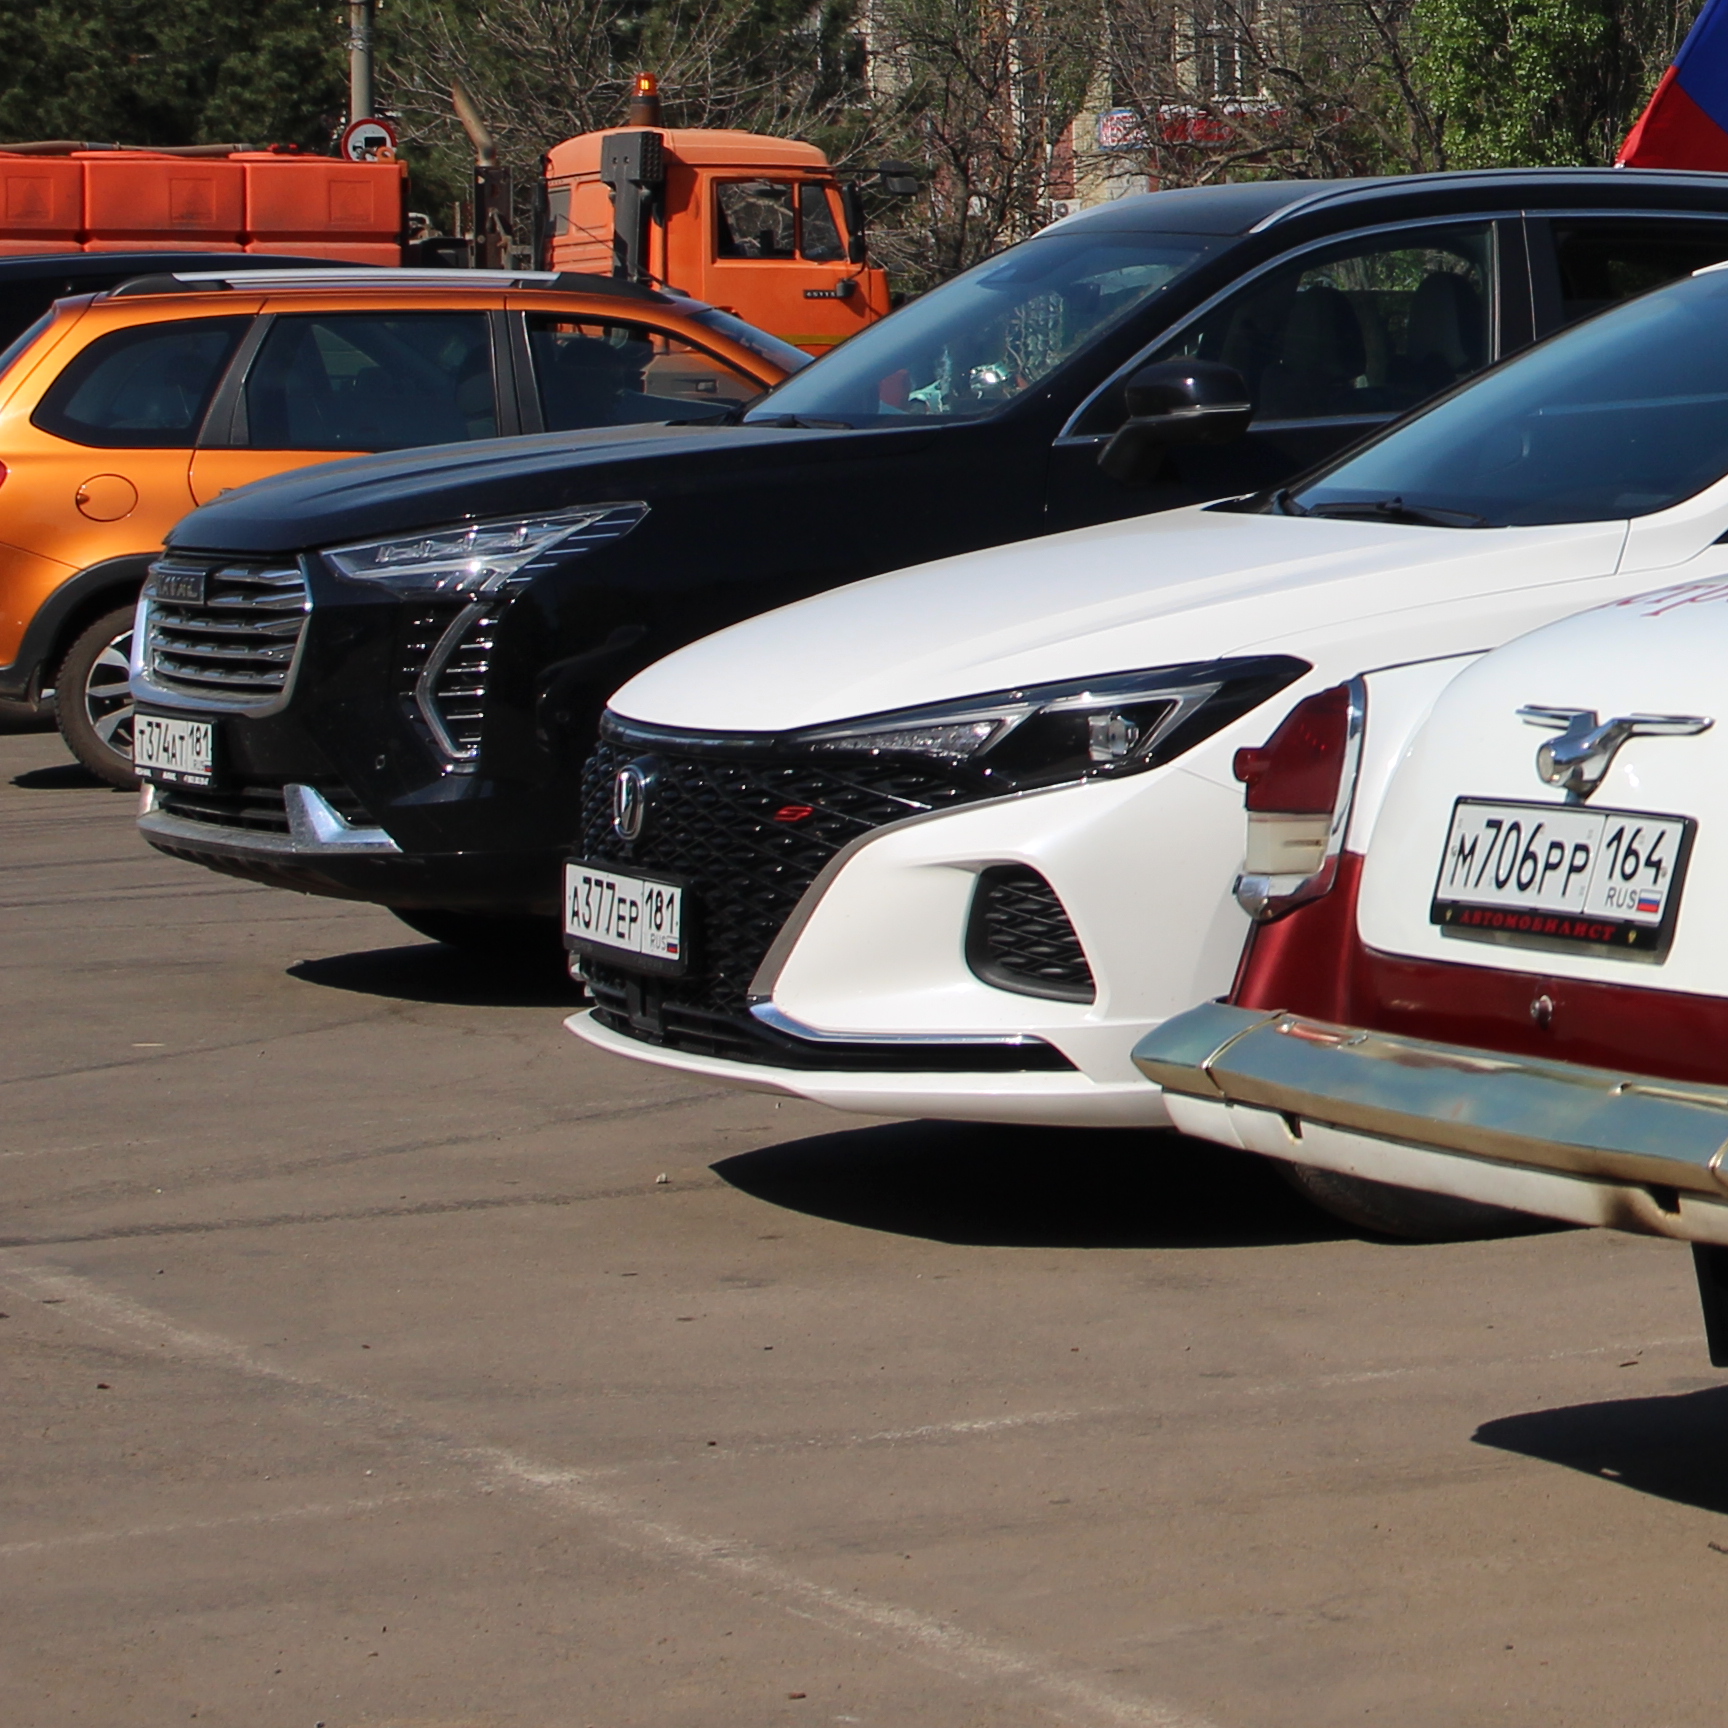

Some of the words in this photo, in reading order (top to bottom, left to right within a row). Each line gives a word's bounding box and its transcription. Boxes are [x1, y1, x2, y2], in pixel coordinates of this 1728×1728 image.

[1605, 825, 1667, 885] 164
[645, 887, 675, 934] 181
[1604, 886, 1638, 909] RUS
[1459, 909, 1617, 941] АВТОМОБИЛИСТ
